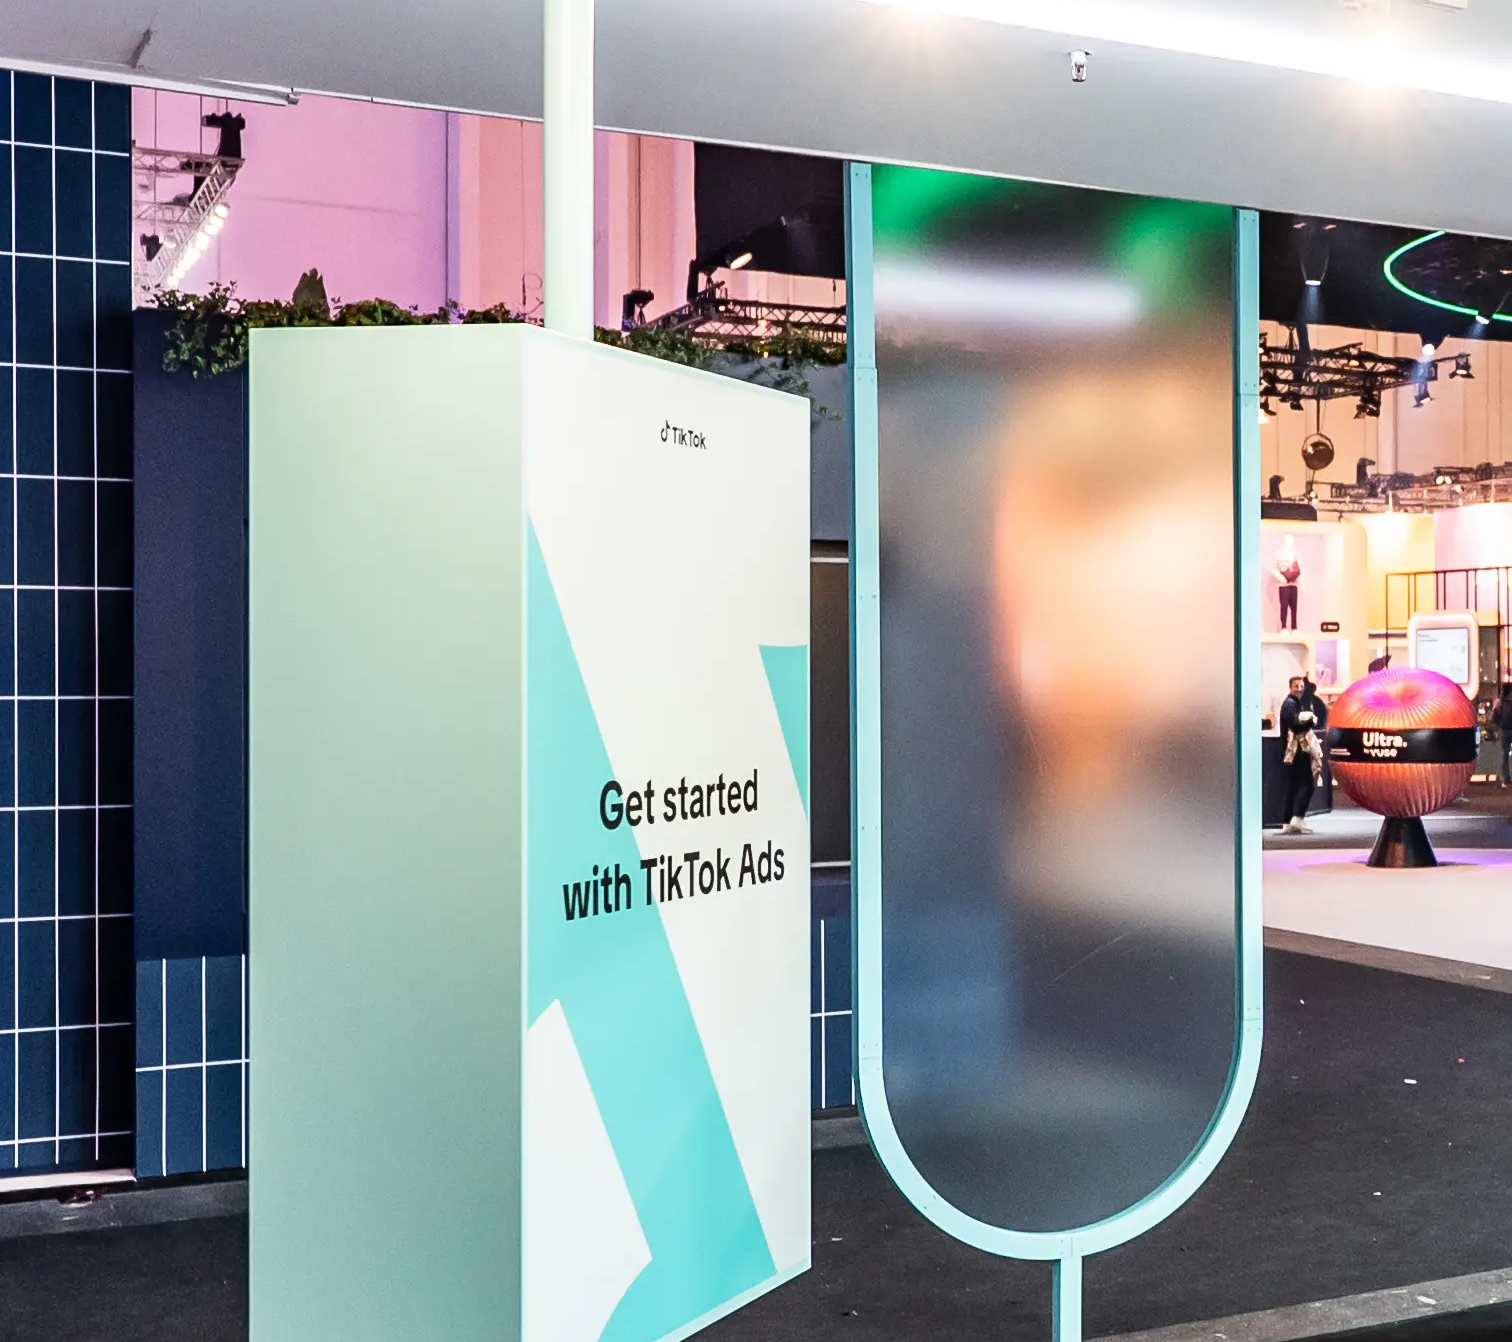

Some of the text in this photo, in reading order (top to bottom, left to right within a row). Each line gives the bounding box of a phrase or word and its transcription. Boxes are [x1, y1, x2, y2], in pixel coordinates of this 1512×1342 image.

[672, 425, 706, 450] TikTok
[1362, 731, 1408, 748] Ultra.
[600, 769, 757, 830] Get started
[563, 841, 784, 920] with TikTok Ads
